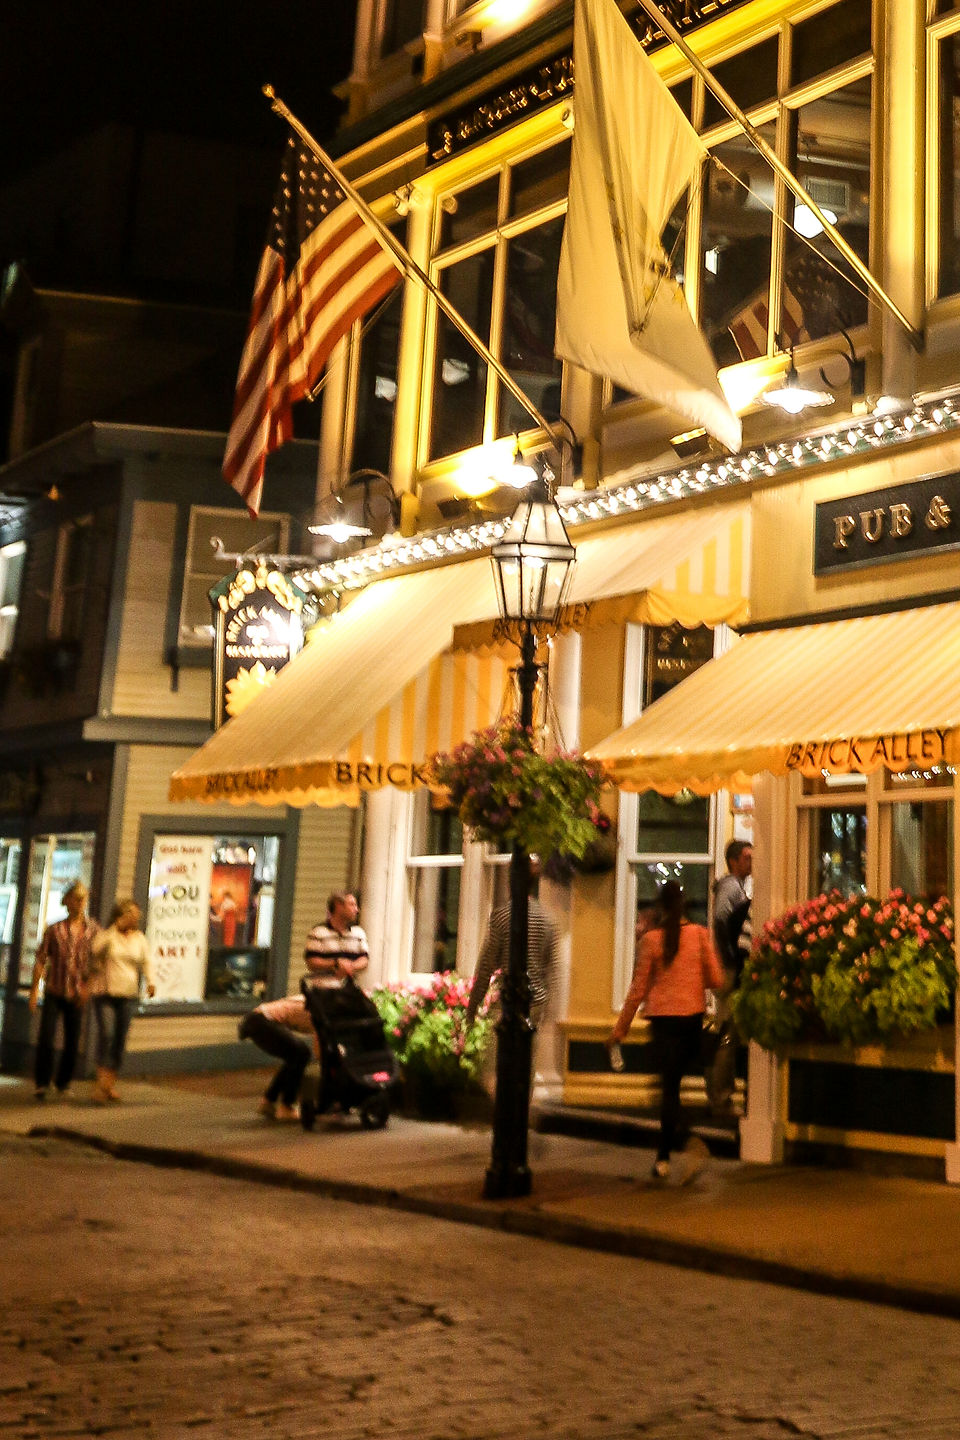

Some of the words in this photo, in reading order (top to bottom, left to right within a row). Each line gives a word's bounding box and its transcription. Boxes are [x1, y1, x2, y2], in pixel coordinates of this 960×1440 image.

[832, 503, 913, 549] PUB
[925, 495, 951, 531] &
[785, 737, 862, 769] BRICK
[871, 728, 952, 762] ALLEY
[335, 761, 430, 786] BRICK
